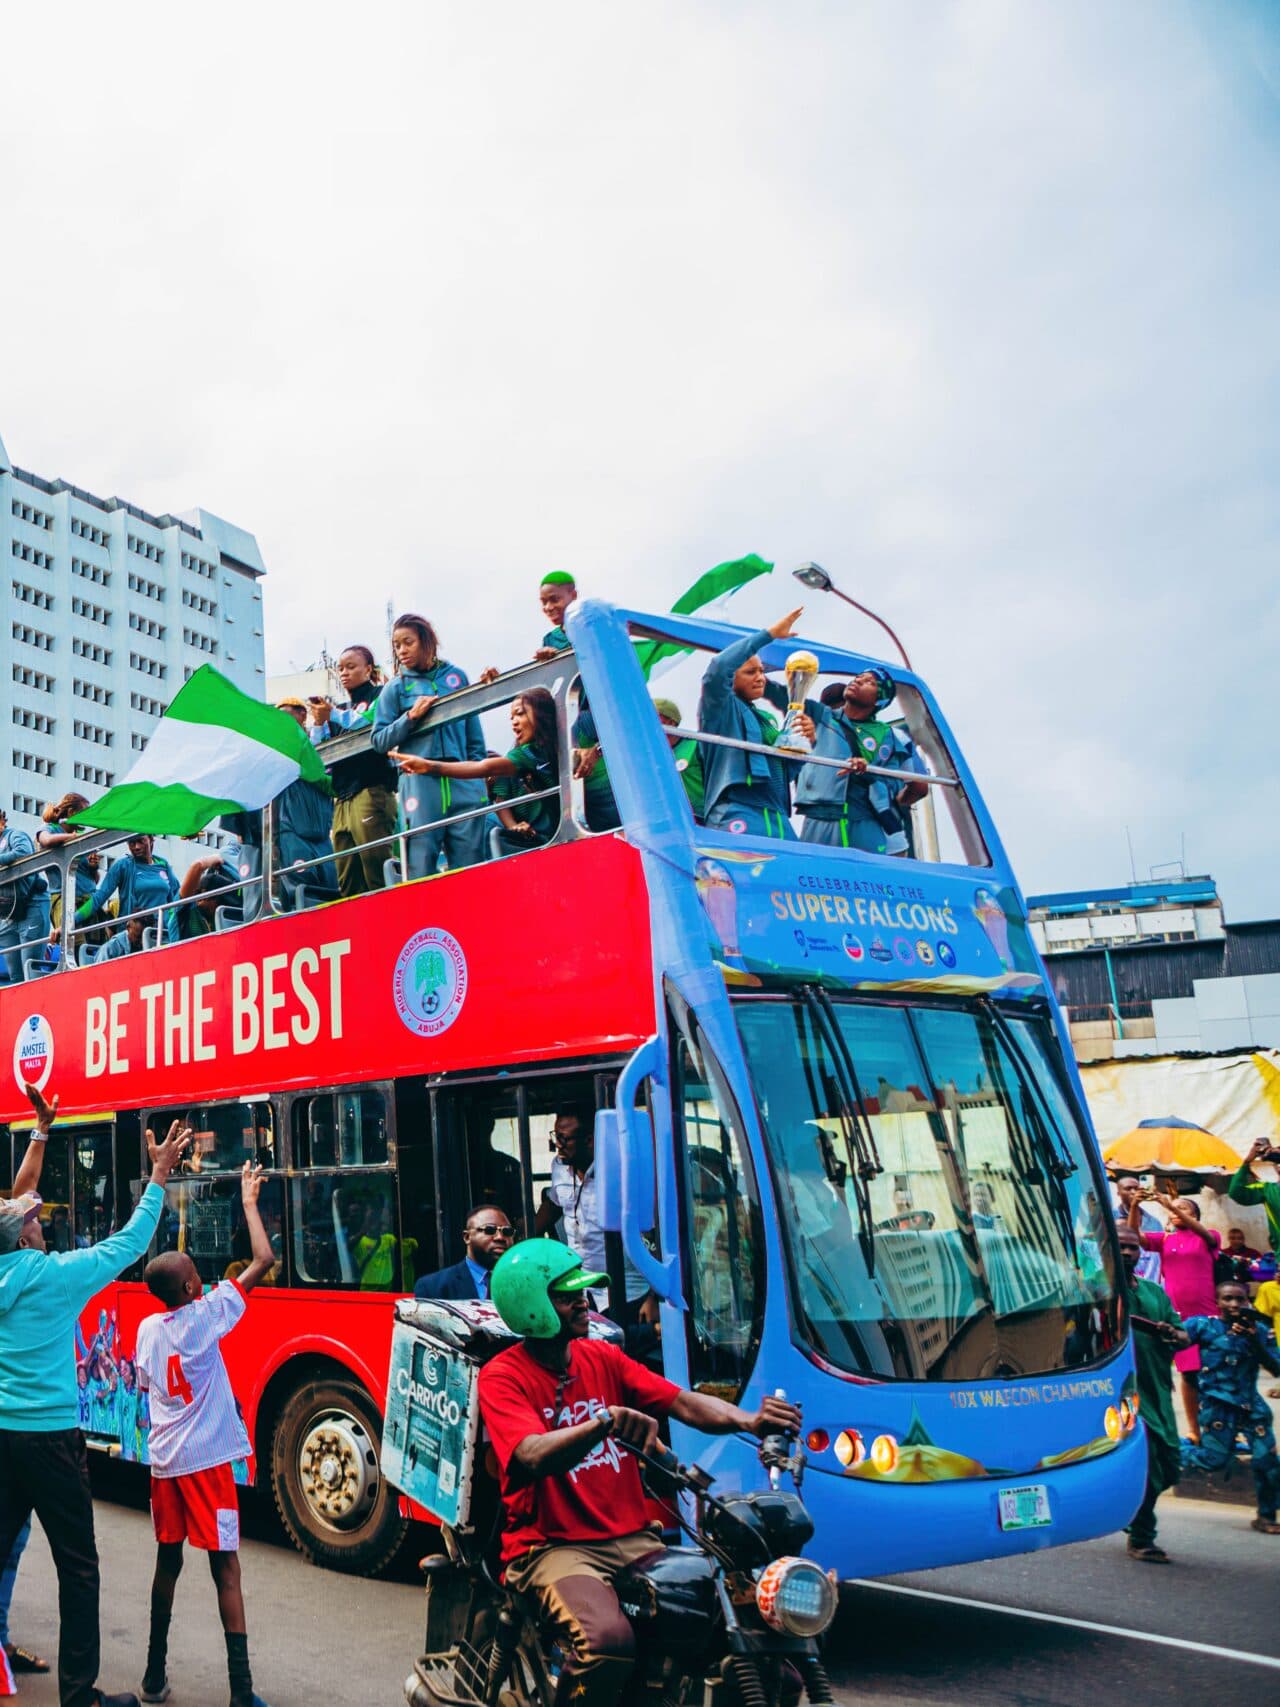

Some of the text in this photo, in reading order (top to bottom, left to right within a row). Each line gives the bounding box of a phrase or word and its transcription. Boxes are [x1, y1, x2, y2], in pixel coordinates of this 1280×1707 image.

[798, 875, 925, 899] CELEBRATING THE
[771, 891, 958, 934] SUPER FALCONS
[395, 932, 465, 1014] NIGERIA FOOTBALL ASSOCIATION
[85, 939, 351, 1078] BE THE BEST
[417, 1020, 445, 1033] ABUJA
[22, 1042, 46, 1057] AMSTEL
[167, 1354, 194, 1406] 4
[950, 1378, 1115, 1408] 10X WAFCON CHAMPIONS
